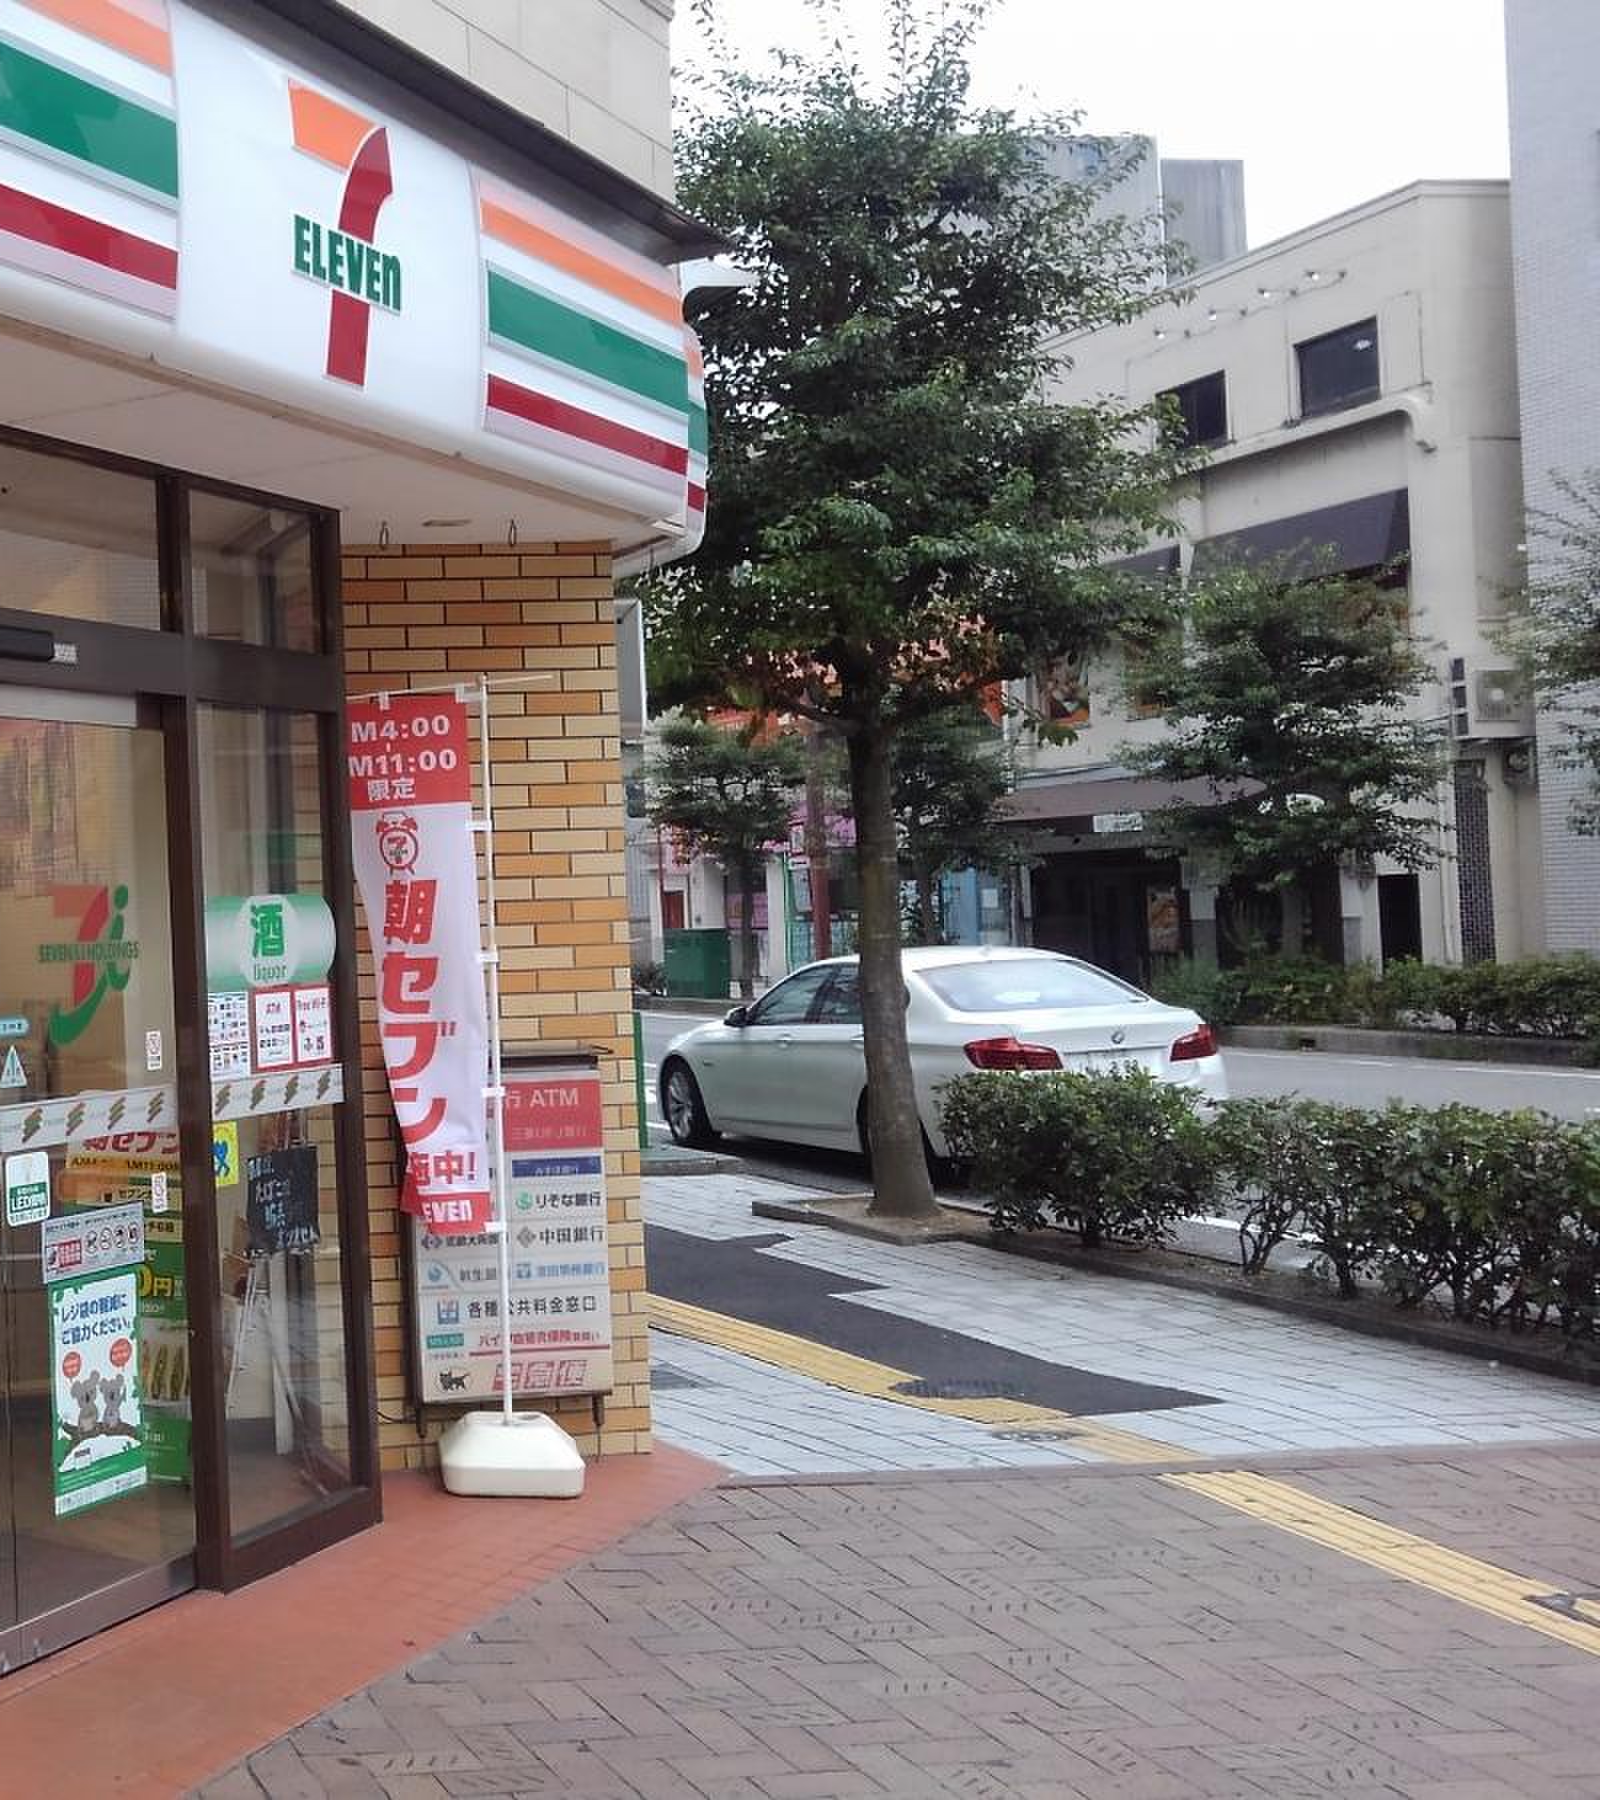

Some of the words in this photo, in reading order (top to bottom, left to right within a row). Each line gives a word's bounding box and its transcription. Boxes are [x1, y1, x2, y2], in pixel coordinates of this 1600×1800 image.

[368, 777, 416, 803] 限定
[250, 904, 285, 958] 酒
[381, 879, 457, 1145] 朝セブン
[530, 1088, 579, 1108] ATM
[536, 1190, 601, 1209] りそな銀行
[539, 1225, 605, 1246] 中国銀行
